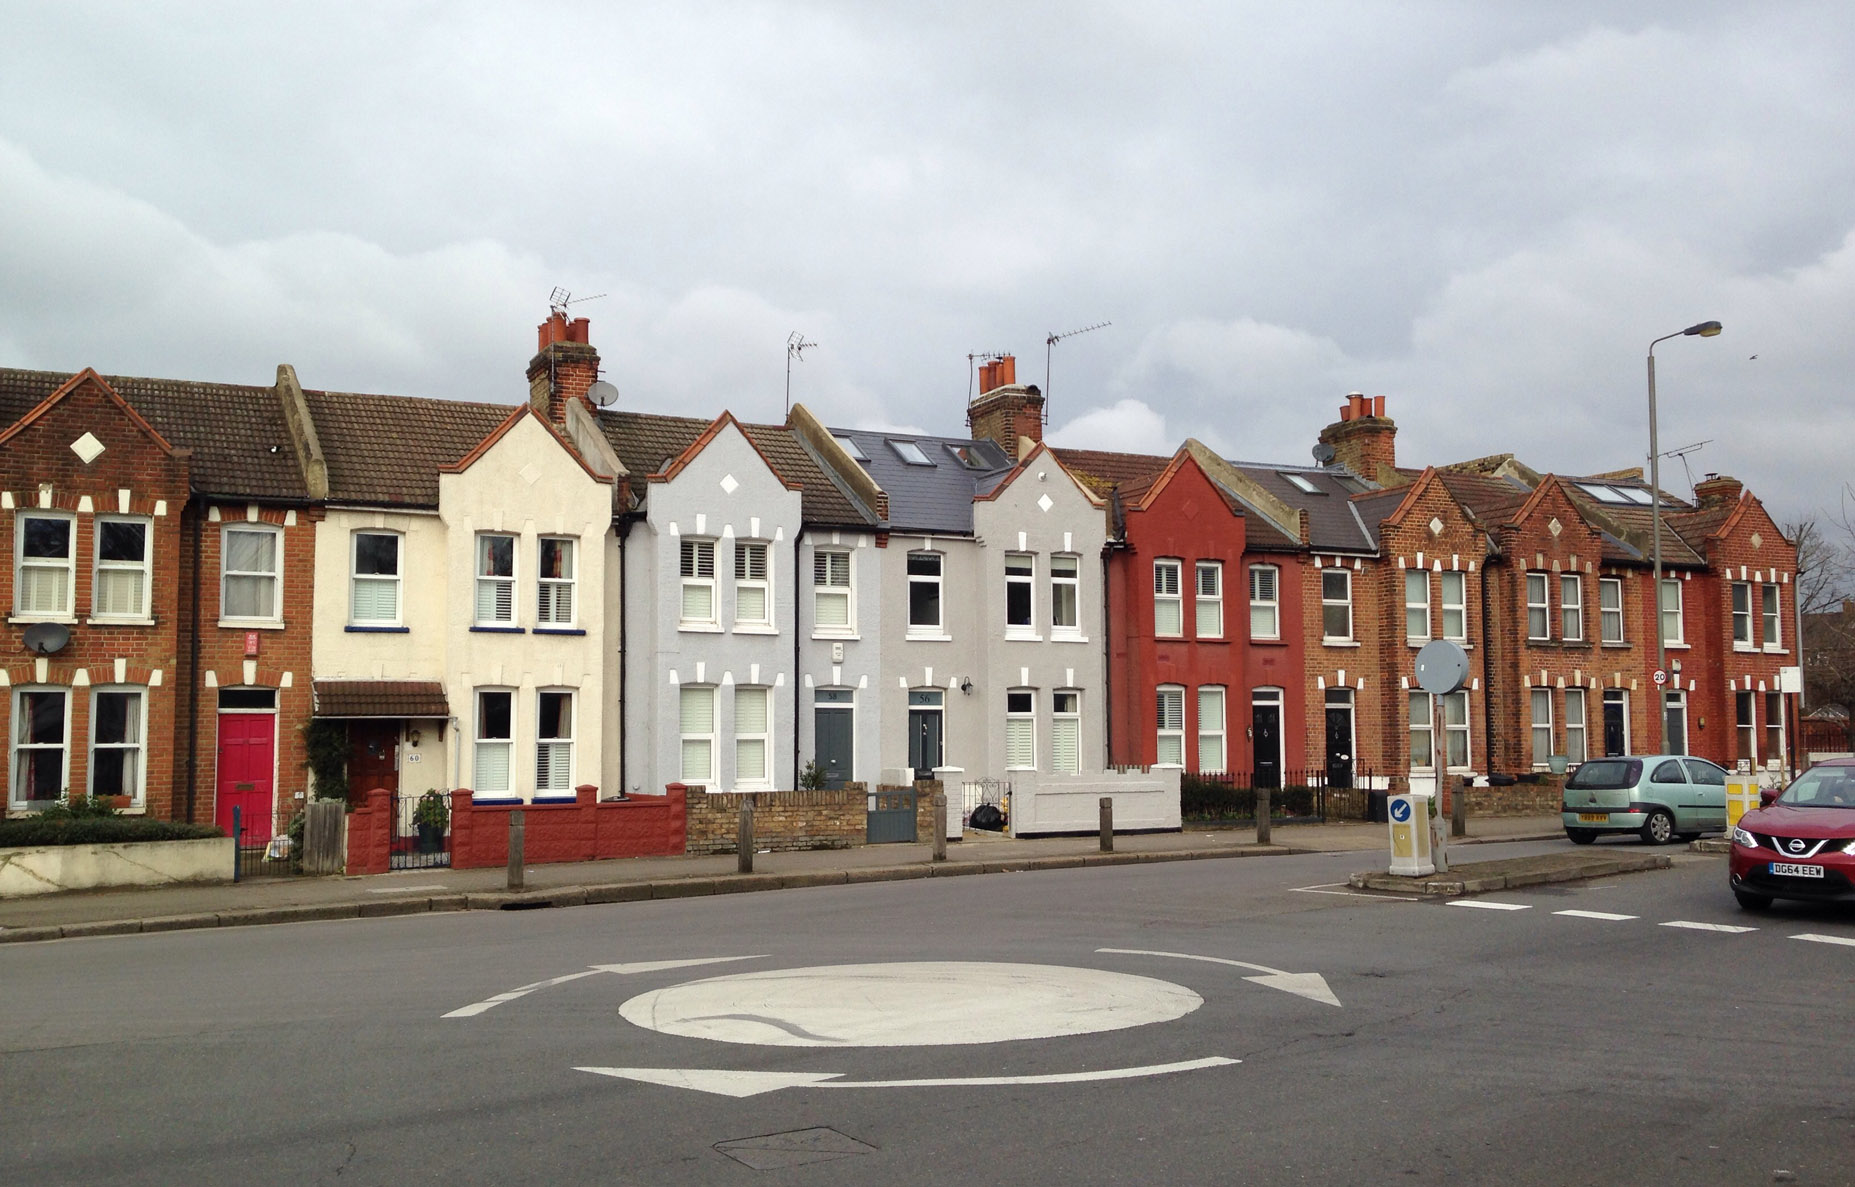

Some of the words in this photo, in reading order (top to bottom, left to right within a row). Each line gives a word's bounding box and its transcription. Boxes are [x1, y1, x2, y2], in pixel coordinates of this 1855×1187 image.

[1654, 673, 1665, 681] 20
[919, 694, 930, 703] 56
[409, 754, 420, 762] 60
[1775, 864, 1799, 875] DG64
[1802, 865, 1822, 876] EEW
